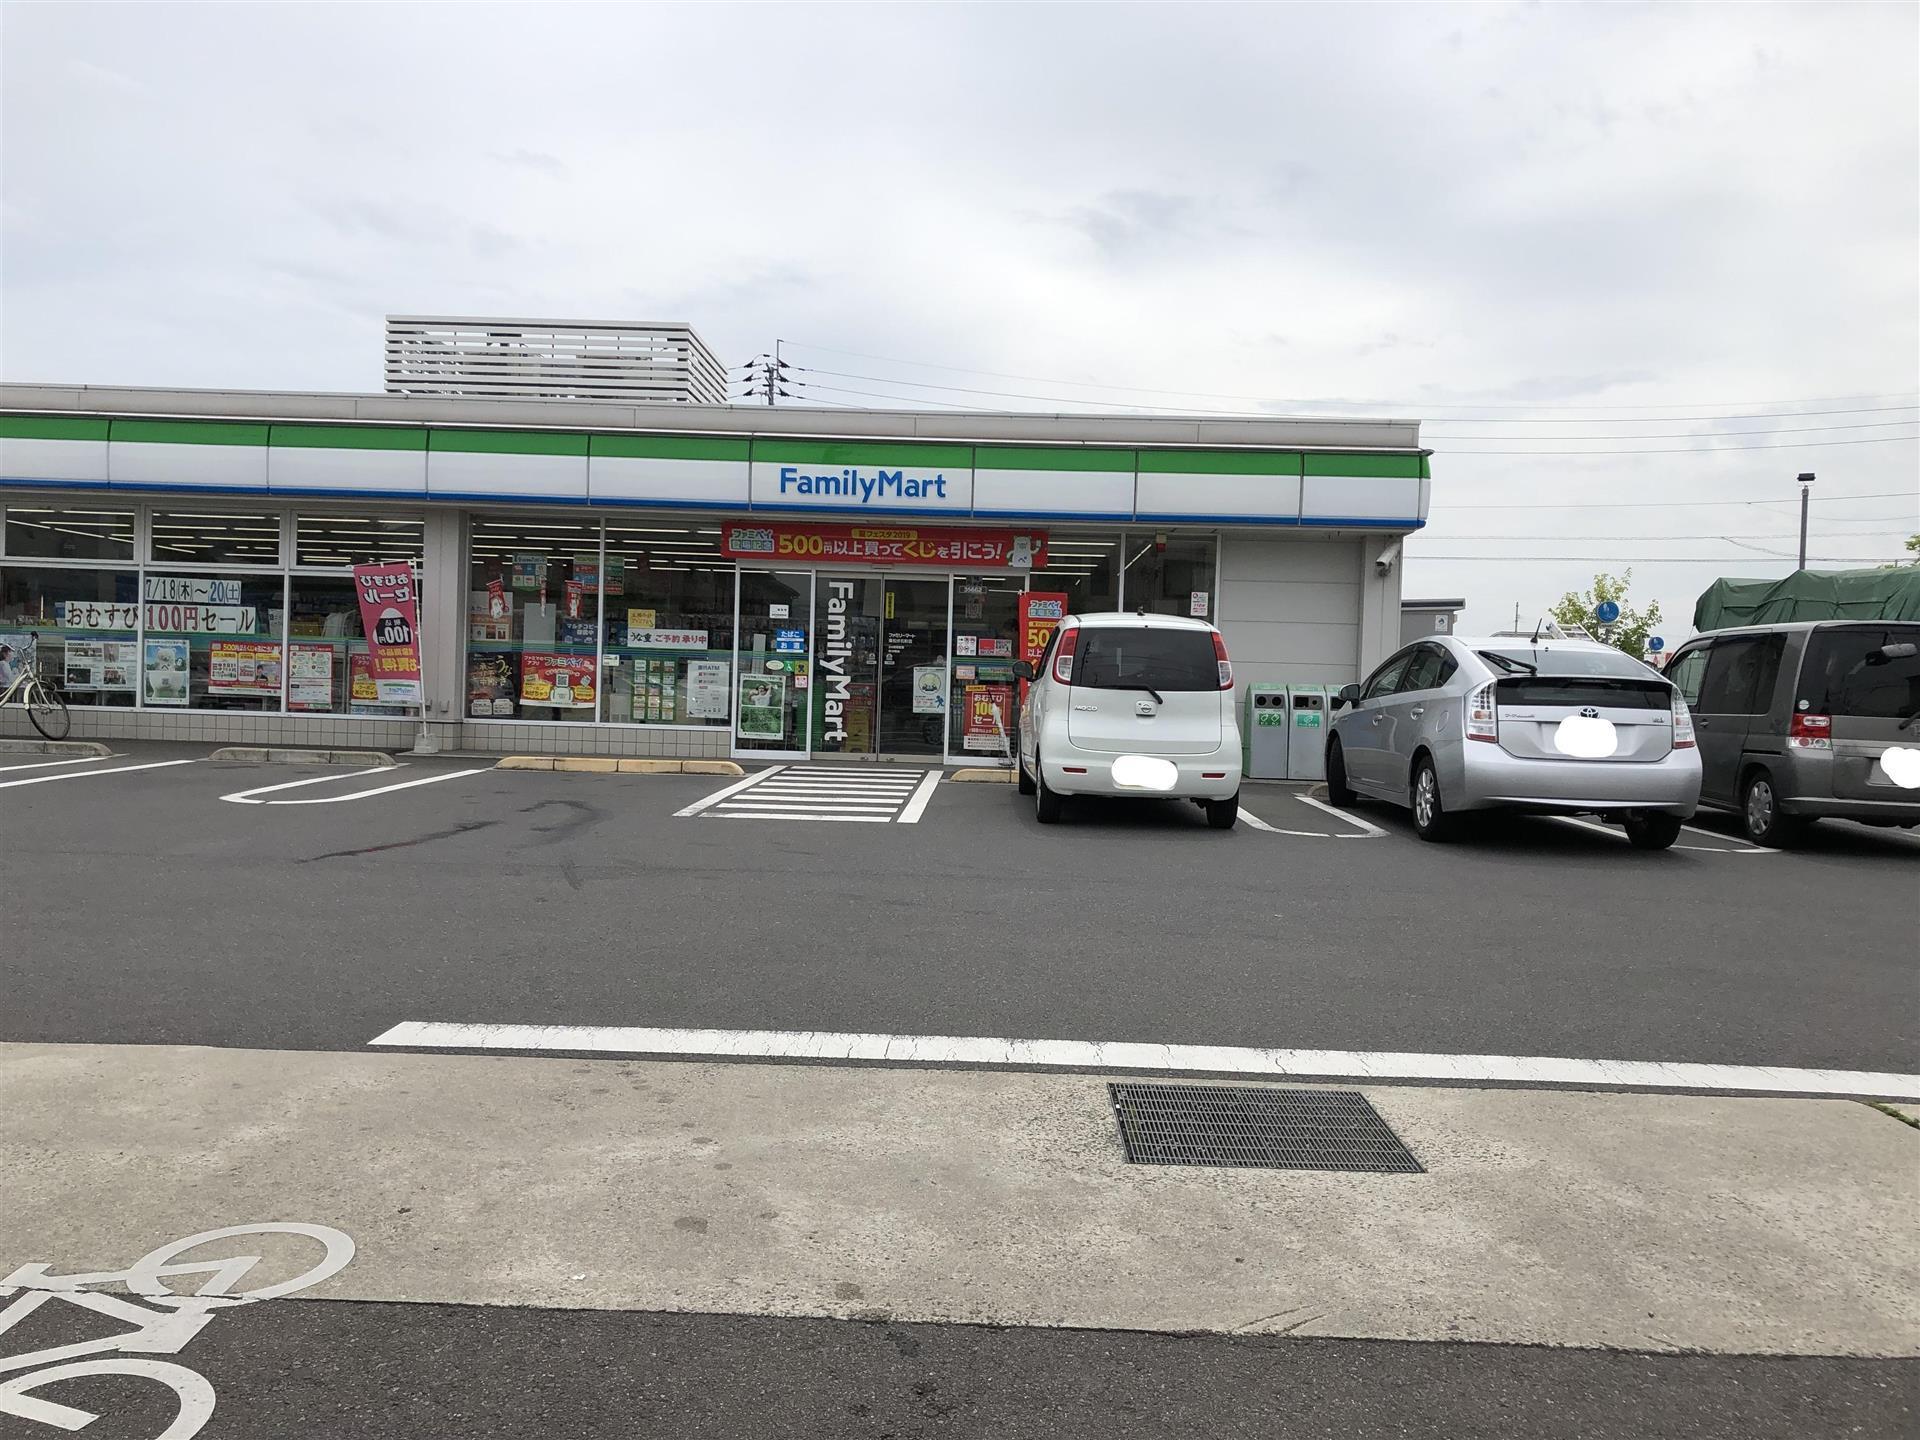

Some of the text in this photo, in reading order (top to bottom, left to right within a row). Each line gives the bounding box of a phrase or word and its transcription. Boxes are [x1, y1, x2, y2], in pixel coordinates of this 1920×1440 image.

[780, 467, 946, 503] FamilyMart
[731, 528, 774, 540] ファミペイ
[1029, 600, 1061, 608] ファミペイ
[67, 602, 255, 632] おむすび 100円セール
[780, 630, 800, 638] たばこ
[544, 656, 583, 667] ファミペイ
[819, 581, 854, 741] FamilyMart
